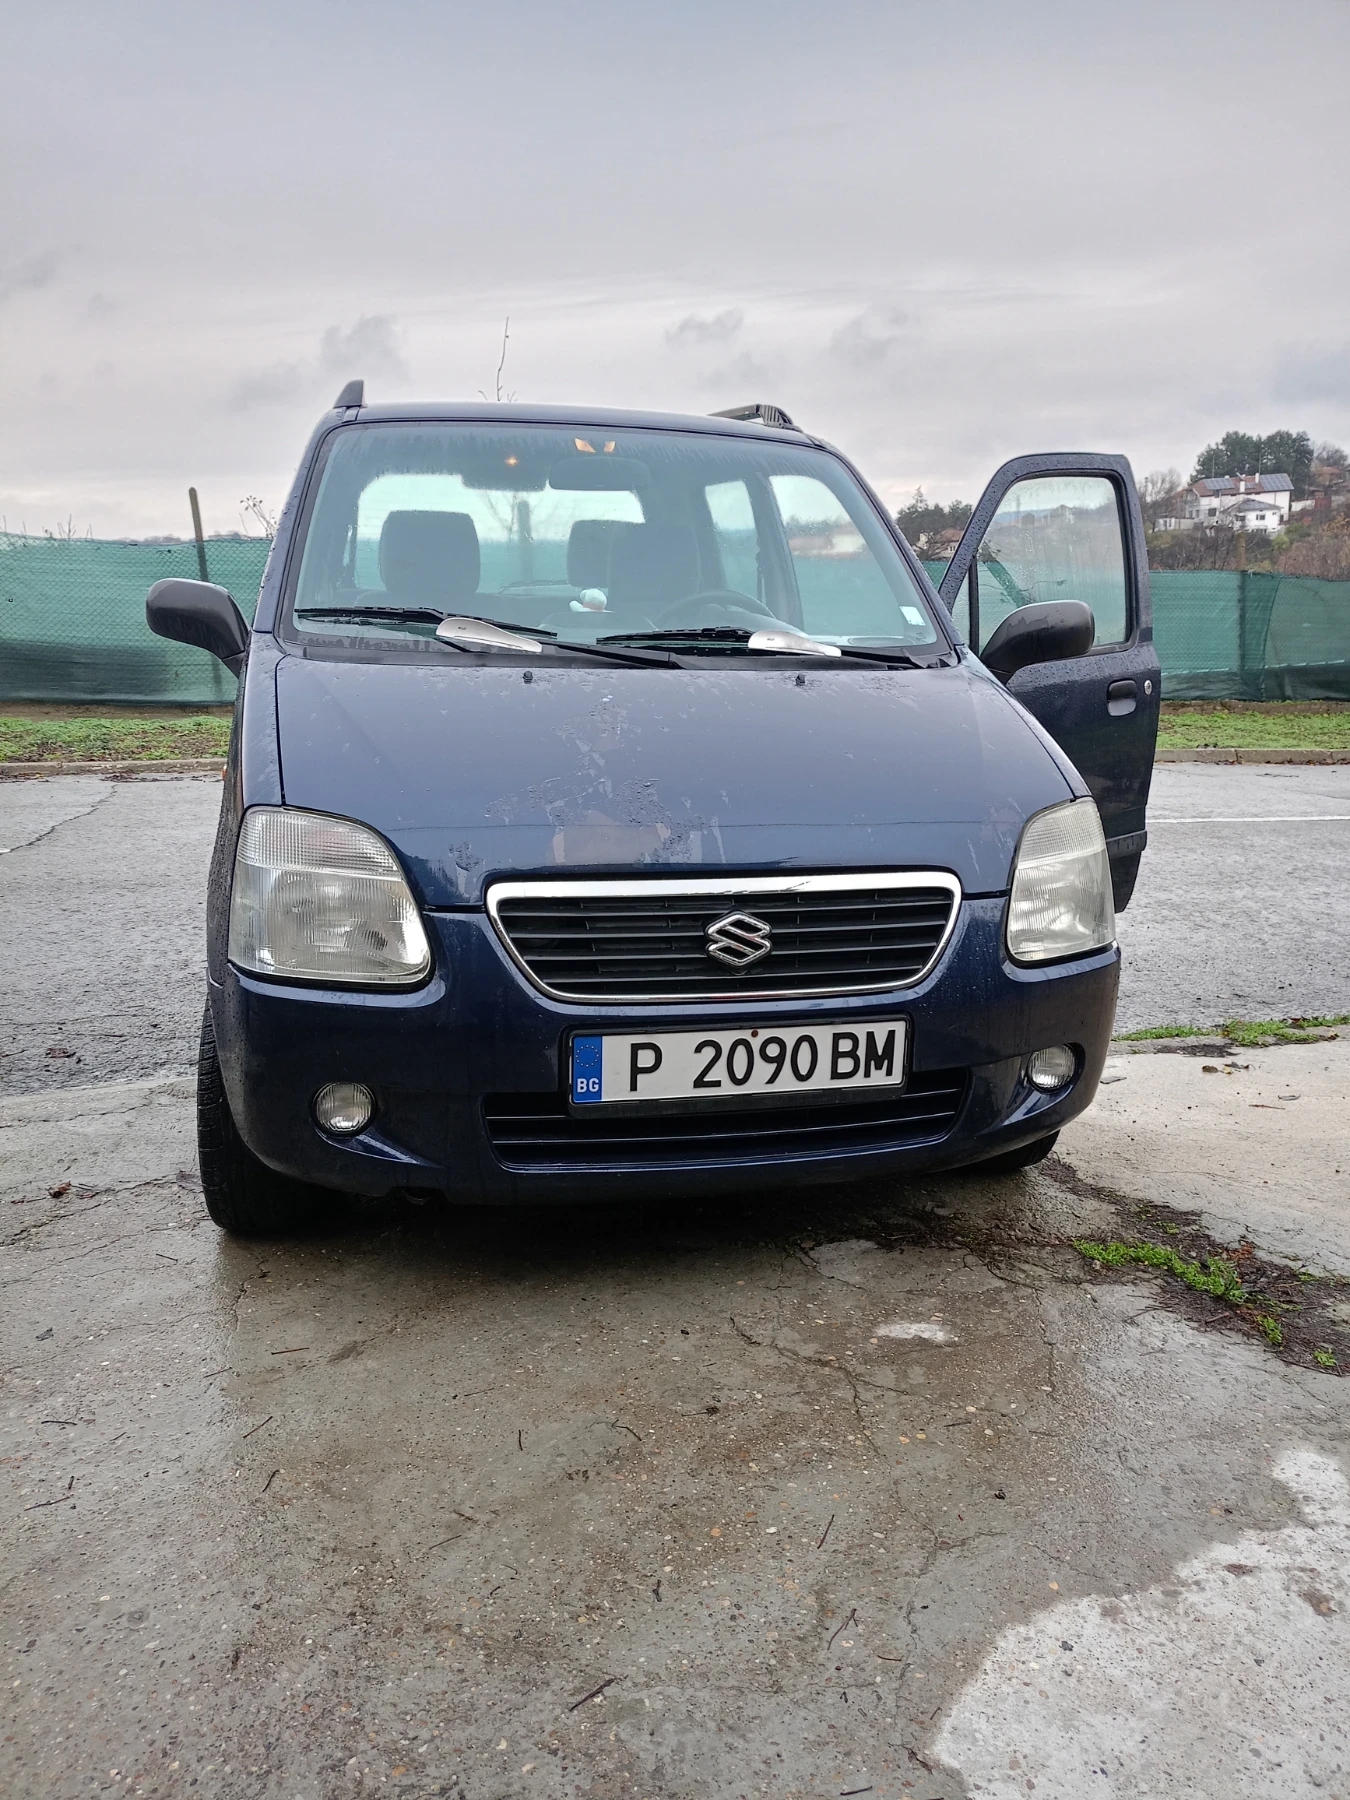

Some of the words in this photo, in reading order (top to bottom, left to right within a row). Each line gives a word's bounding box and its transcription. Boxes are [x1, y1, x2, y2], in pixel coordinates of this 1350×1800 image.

[629, 1041, 663, 1092] P
[692, 1034, 819, 1089] 2090
[829, 1029, 897, 1081] BM
[576, 1077, 600, 1093] BG
